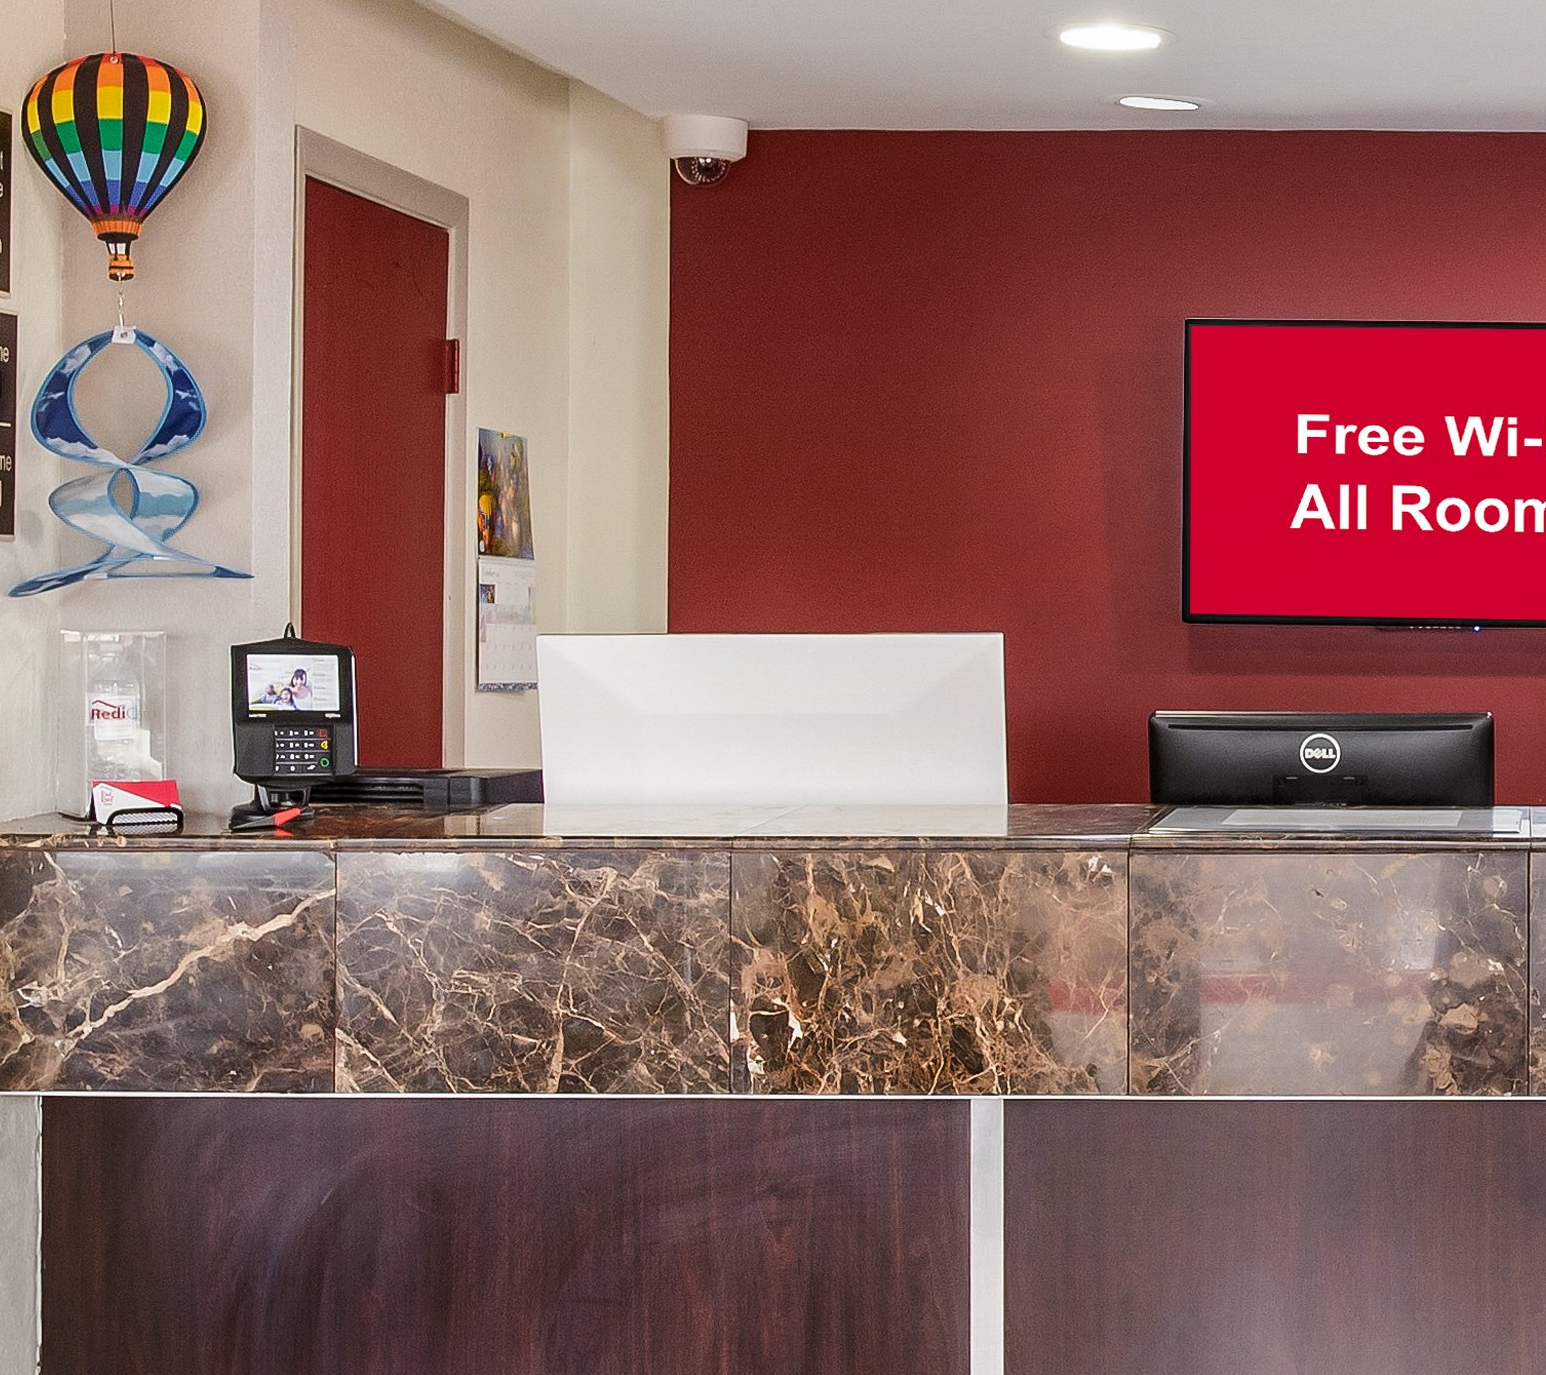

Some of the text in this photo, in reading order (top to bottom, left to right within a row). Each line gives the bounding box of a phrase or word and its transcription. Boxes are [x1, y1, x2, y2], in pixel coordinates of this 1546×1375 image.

[1297, 414, 1425, 456] Free
[1290, 483, 1367, 530] All
[1304, 748, 1336, 759] DELL
